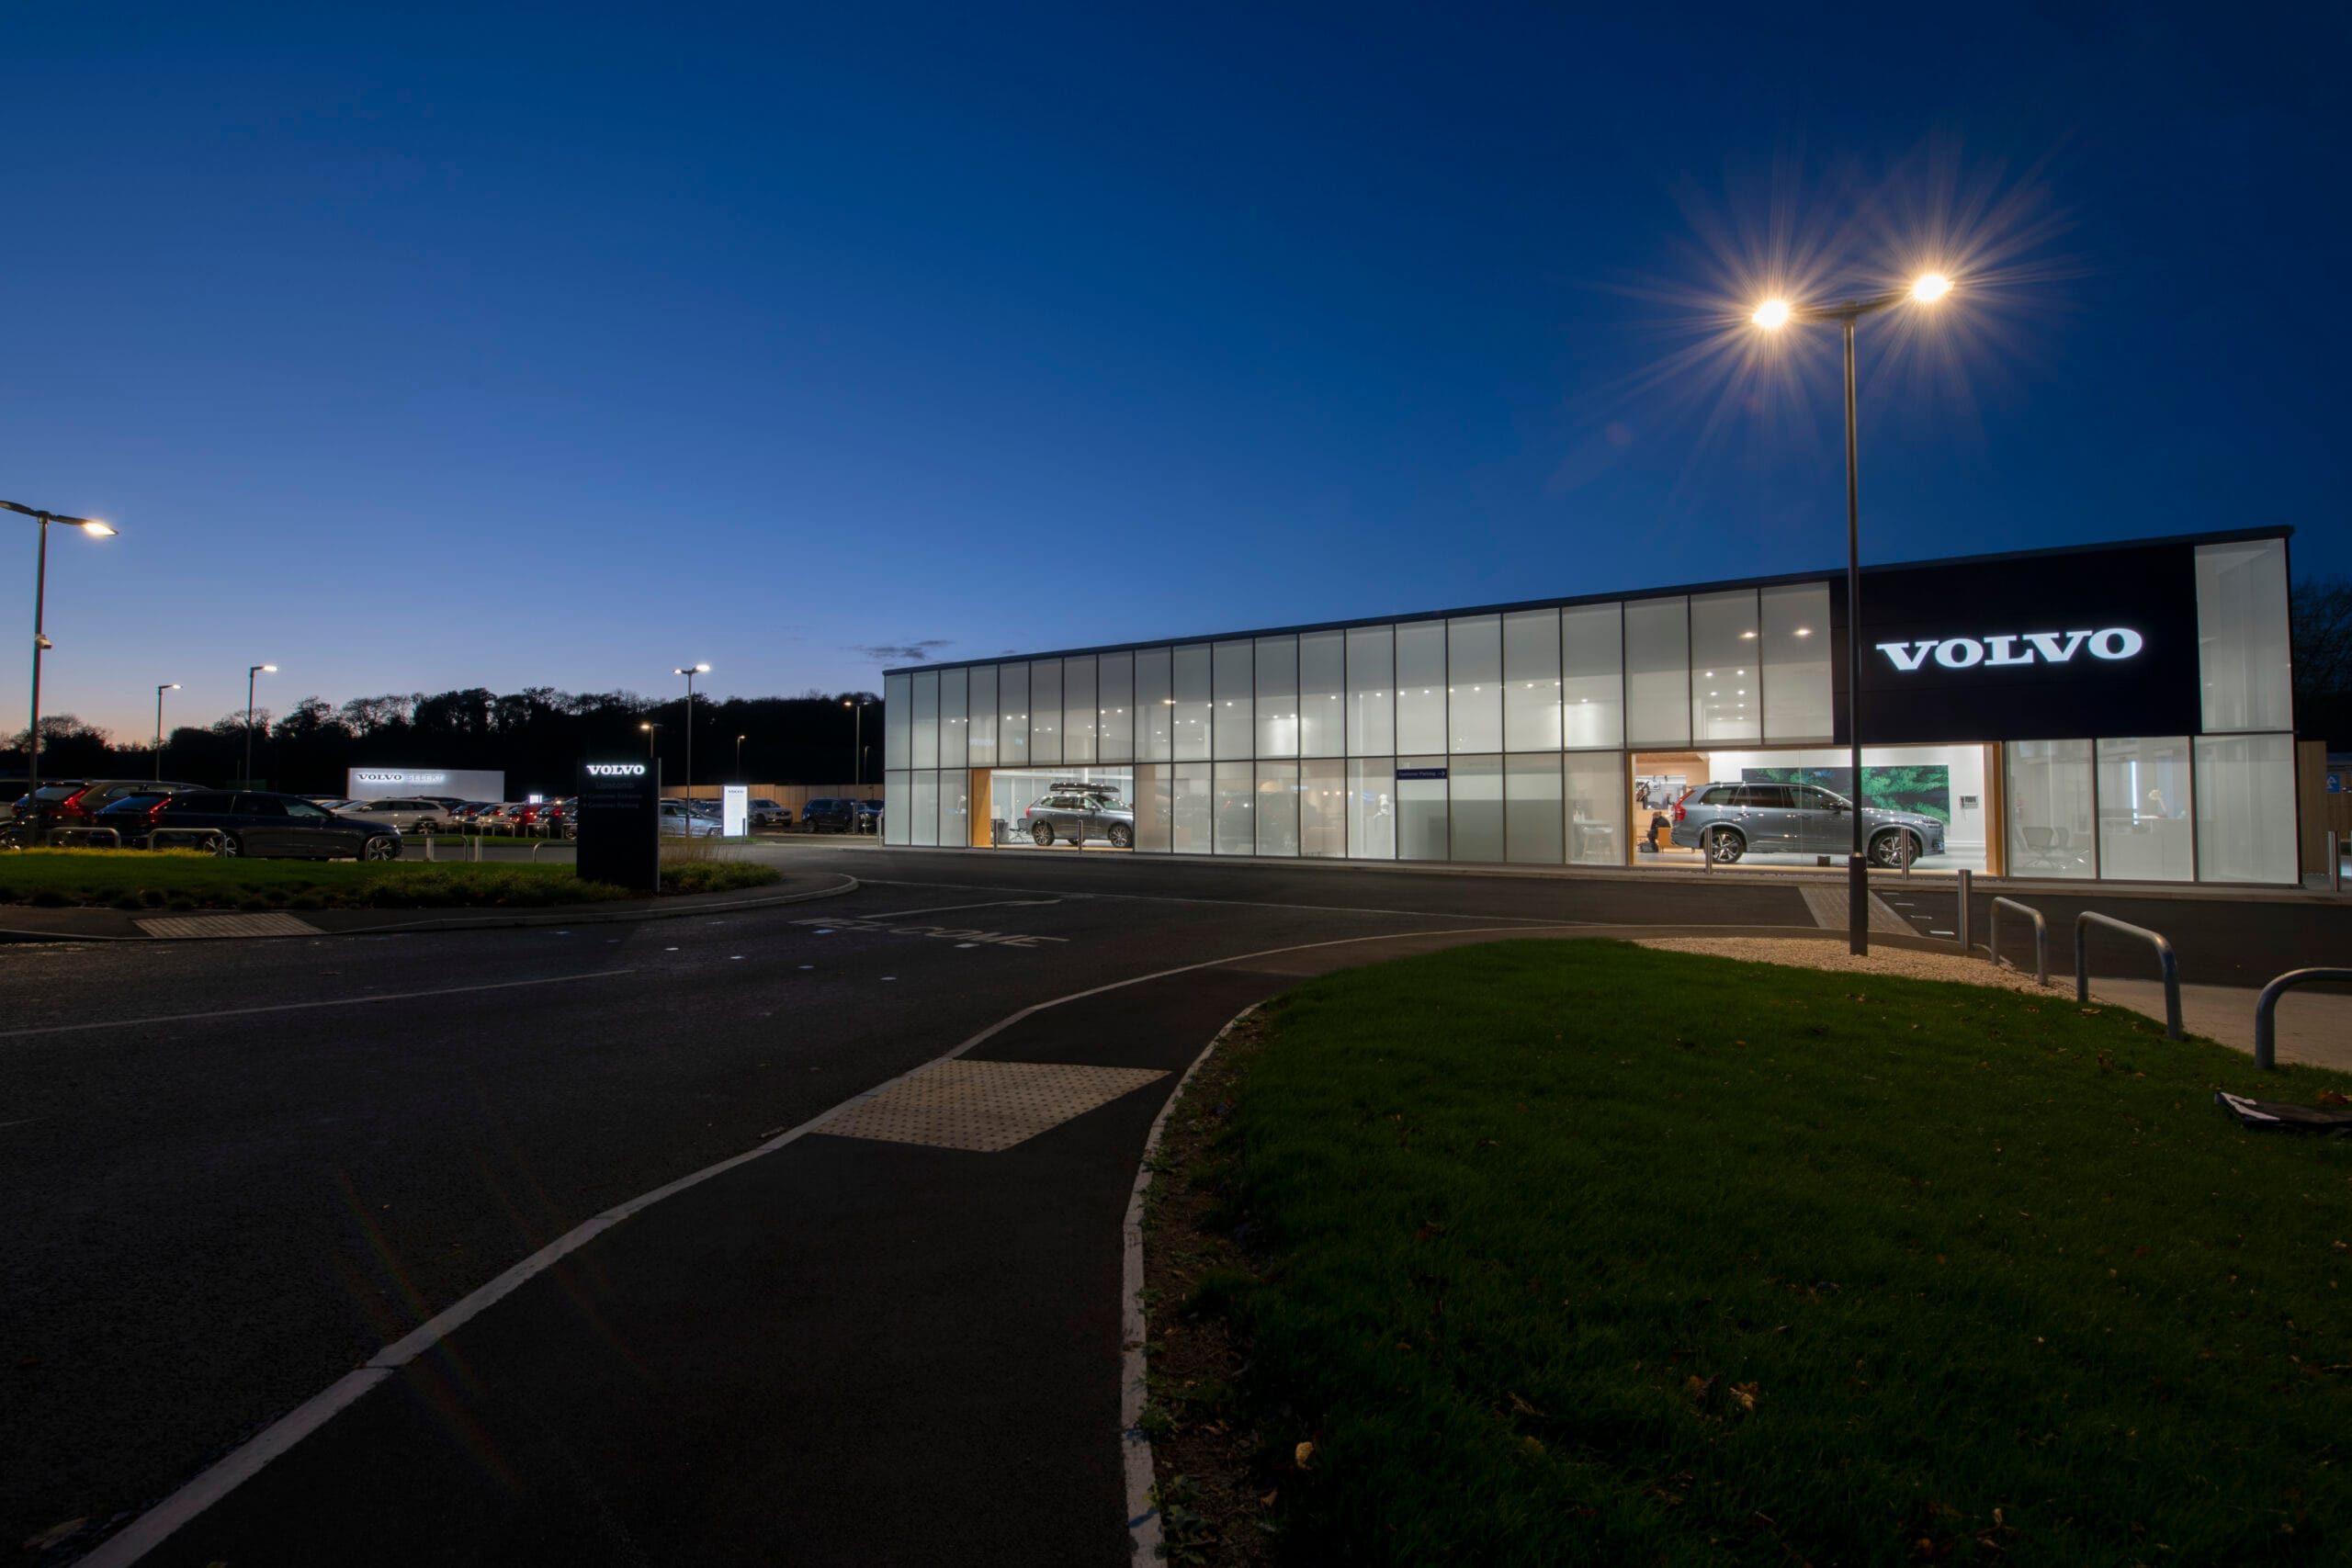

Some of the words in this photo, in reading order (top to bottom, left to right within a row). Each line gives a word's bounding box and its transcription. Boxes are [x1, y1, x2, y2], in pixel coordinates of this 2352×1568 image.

[1875, 627, 2143, 671] VOLVO
[586, 764, 646, 775] VOLVO
[788, 917, 1070, 947] WELCOME
